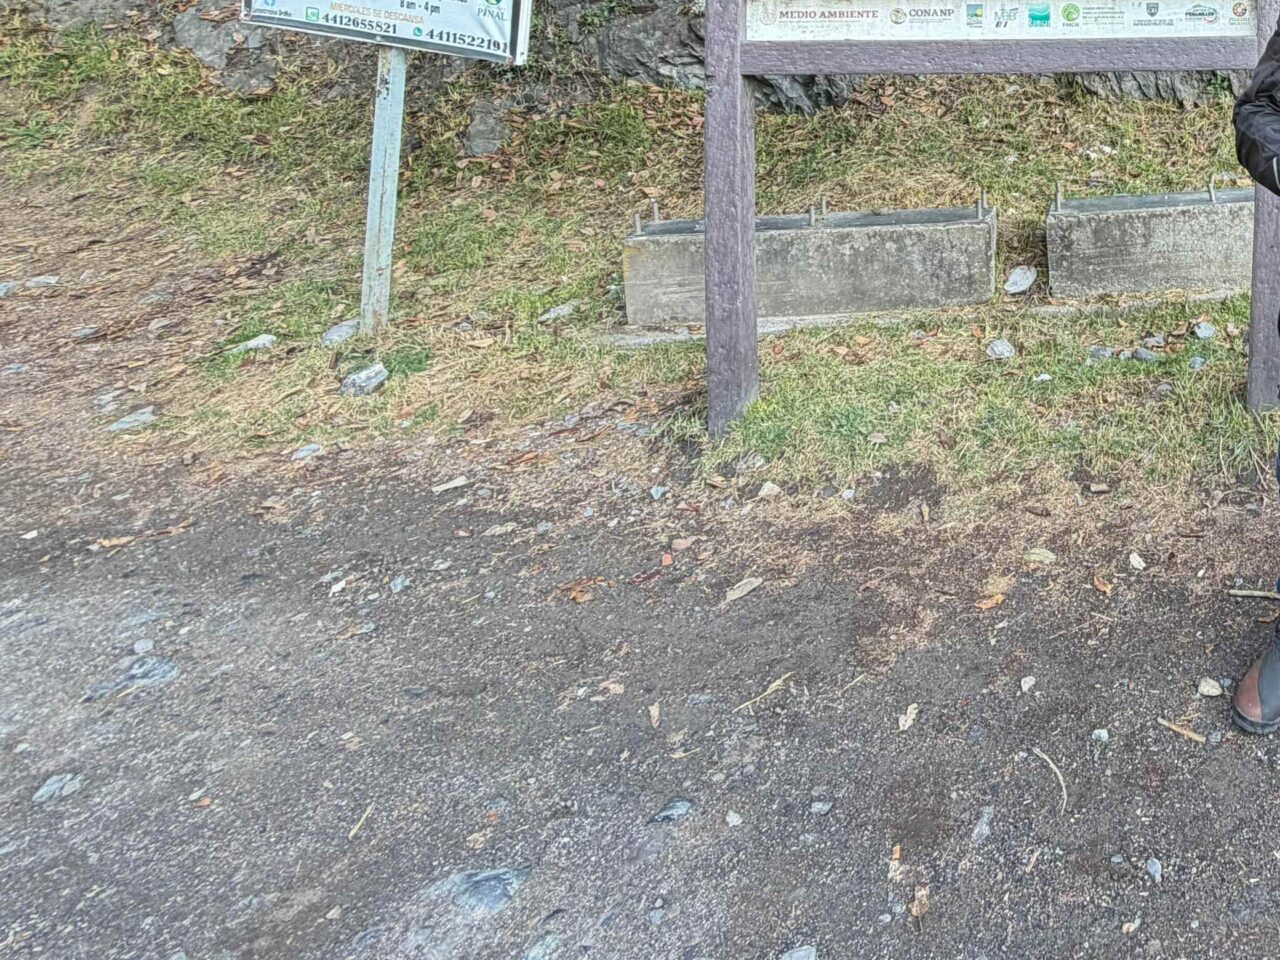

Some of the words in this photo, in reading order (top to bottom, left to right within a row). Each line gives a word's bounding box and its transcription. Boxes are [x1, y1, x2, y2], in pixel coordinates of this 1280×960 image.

[406, 0, 416, 10] am
[423, 2, 429, 12] 4
[429, 5, 440, 15] pm
[477, 8, 508, 22] PINAL
[779, 10, 817, 19] MEDIO
[819, 9, 879, 19] AMBIENTE
[908, 8, 954, 18] CONANP
[322, 12, 397, 35] 4412655821
[384, 9, 424, 24] DESCANSA
[425, 28, 508, 54] 4411522191
